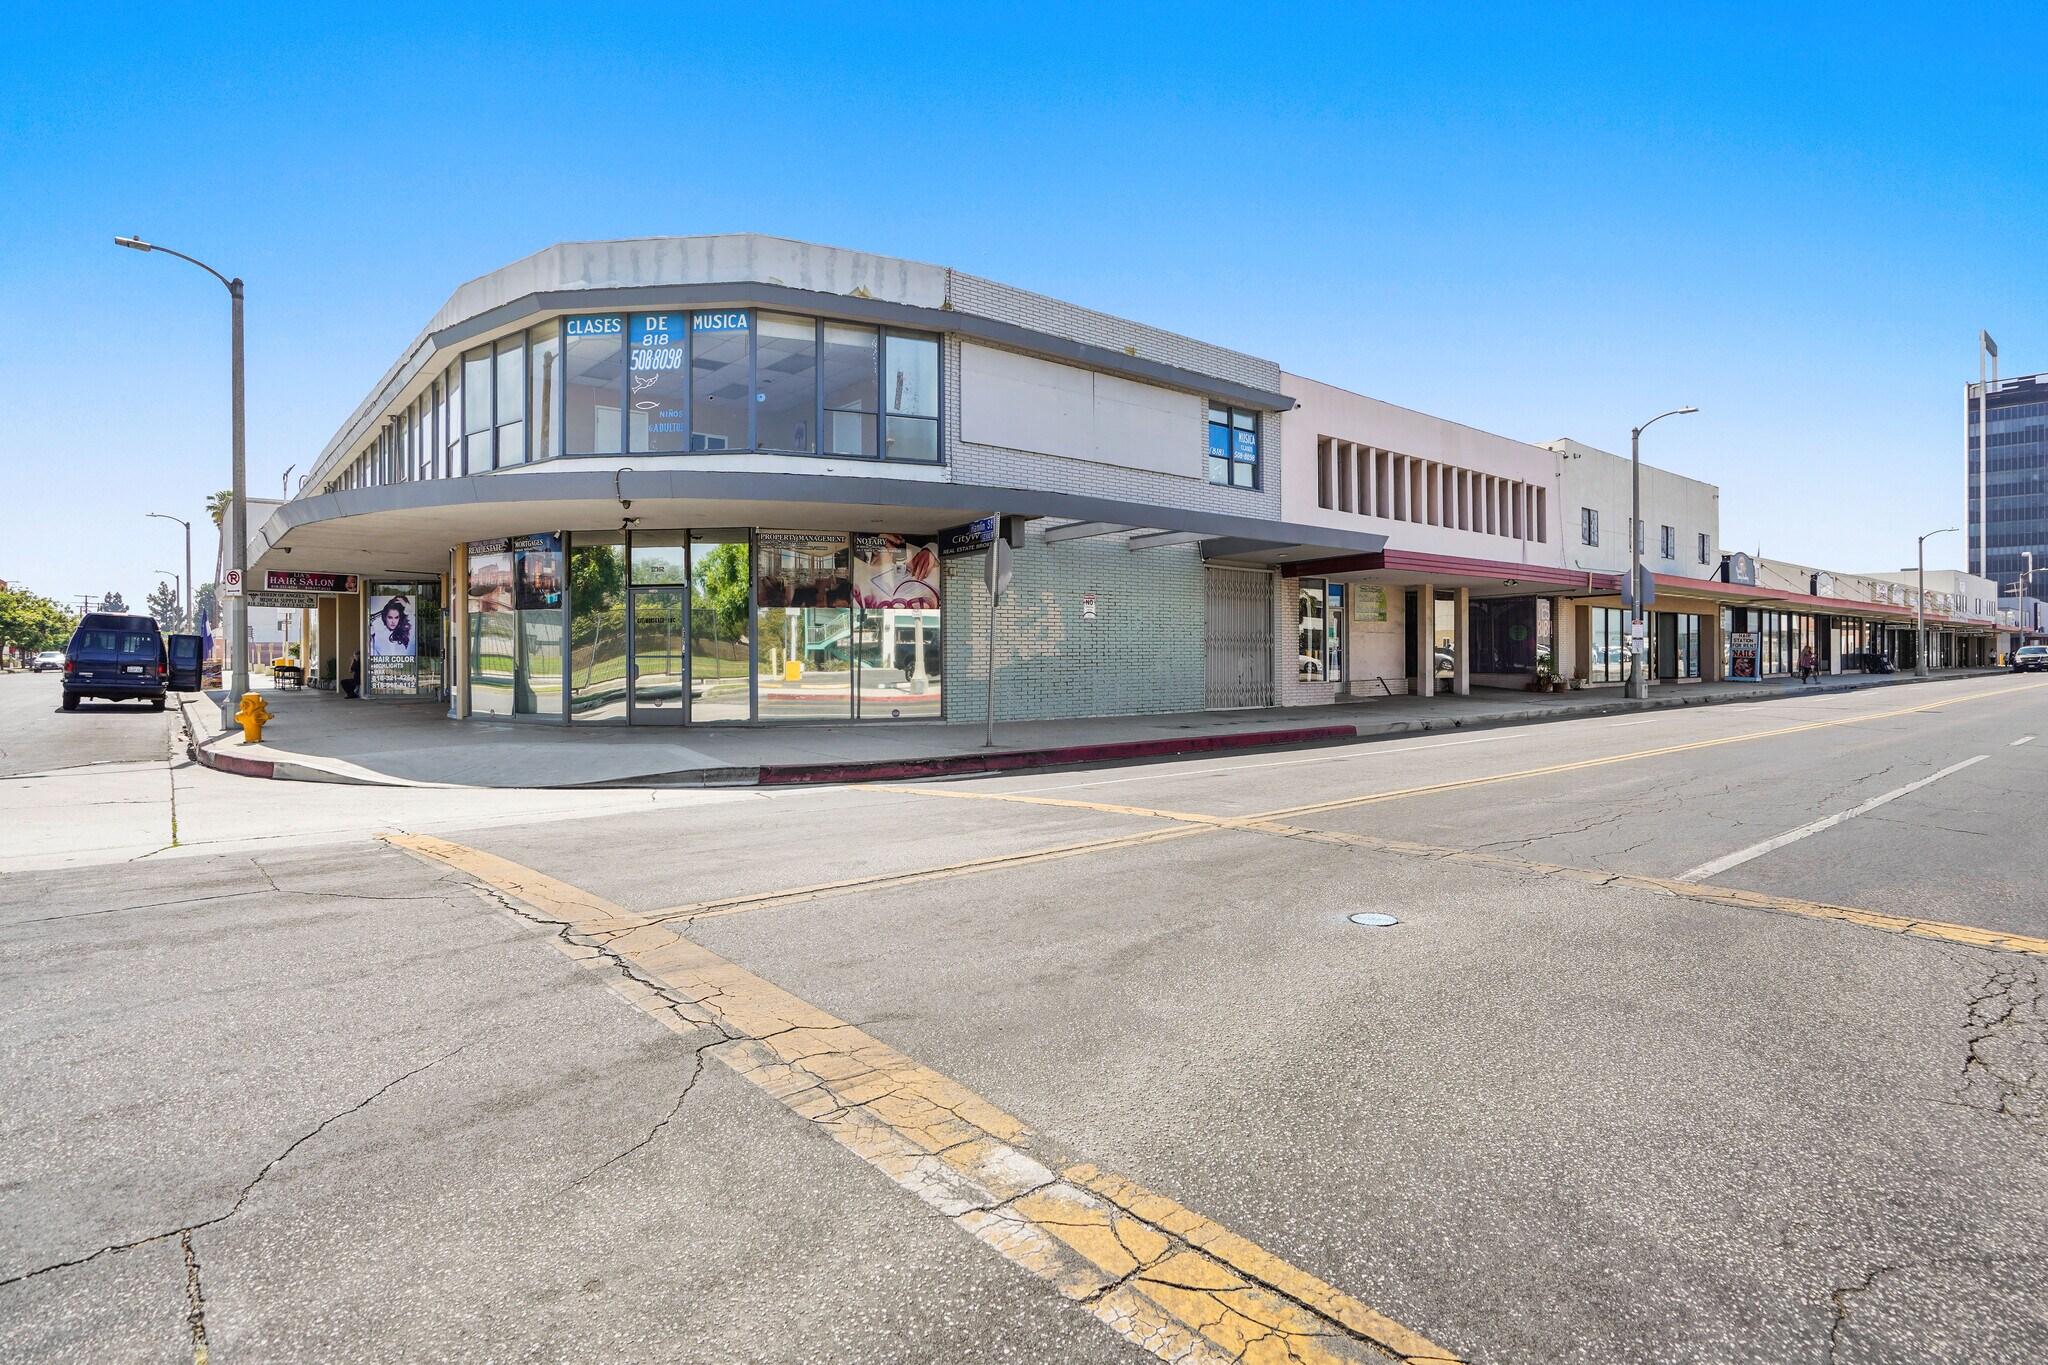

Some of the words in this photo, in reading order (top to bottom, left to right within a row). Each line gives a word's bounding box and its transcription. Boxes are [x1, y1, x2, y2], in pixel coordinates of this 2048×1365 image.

[567, 318, 621, 335] CLASES
[646, 316, 668, 331] DE
[693, 314, 748, 330] MUSICA
[642, 334, 669, 346] 818
[660, 409, 683, 418] NIÑOS
[1238, 432, 1256, 445] MUSICA
[987, 519, 993, 530] St
[760, 533, 797, 541] PROPERTY
[797, 535, 846, 543] MANAGEMENT
[856, 537, 888, 546] NOTARY
[469, 545, 482, 555] REAL
[483, 543, 503, 553] ESTATE
[514, 539, 544, 549] MORTGAGES
[957, 545, 975, 553] ESTATE
[270, 577, 297, 585] HAIR
[299, 578, 335, 587] SALON
